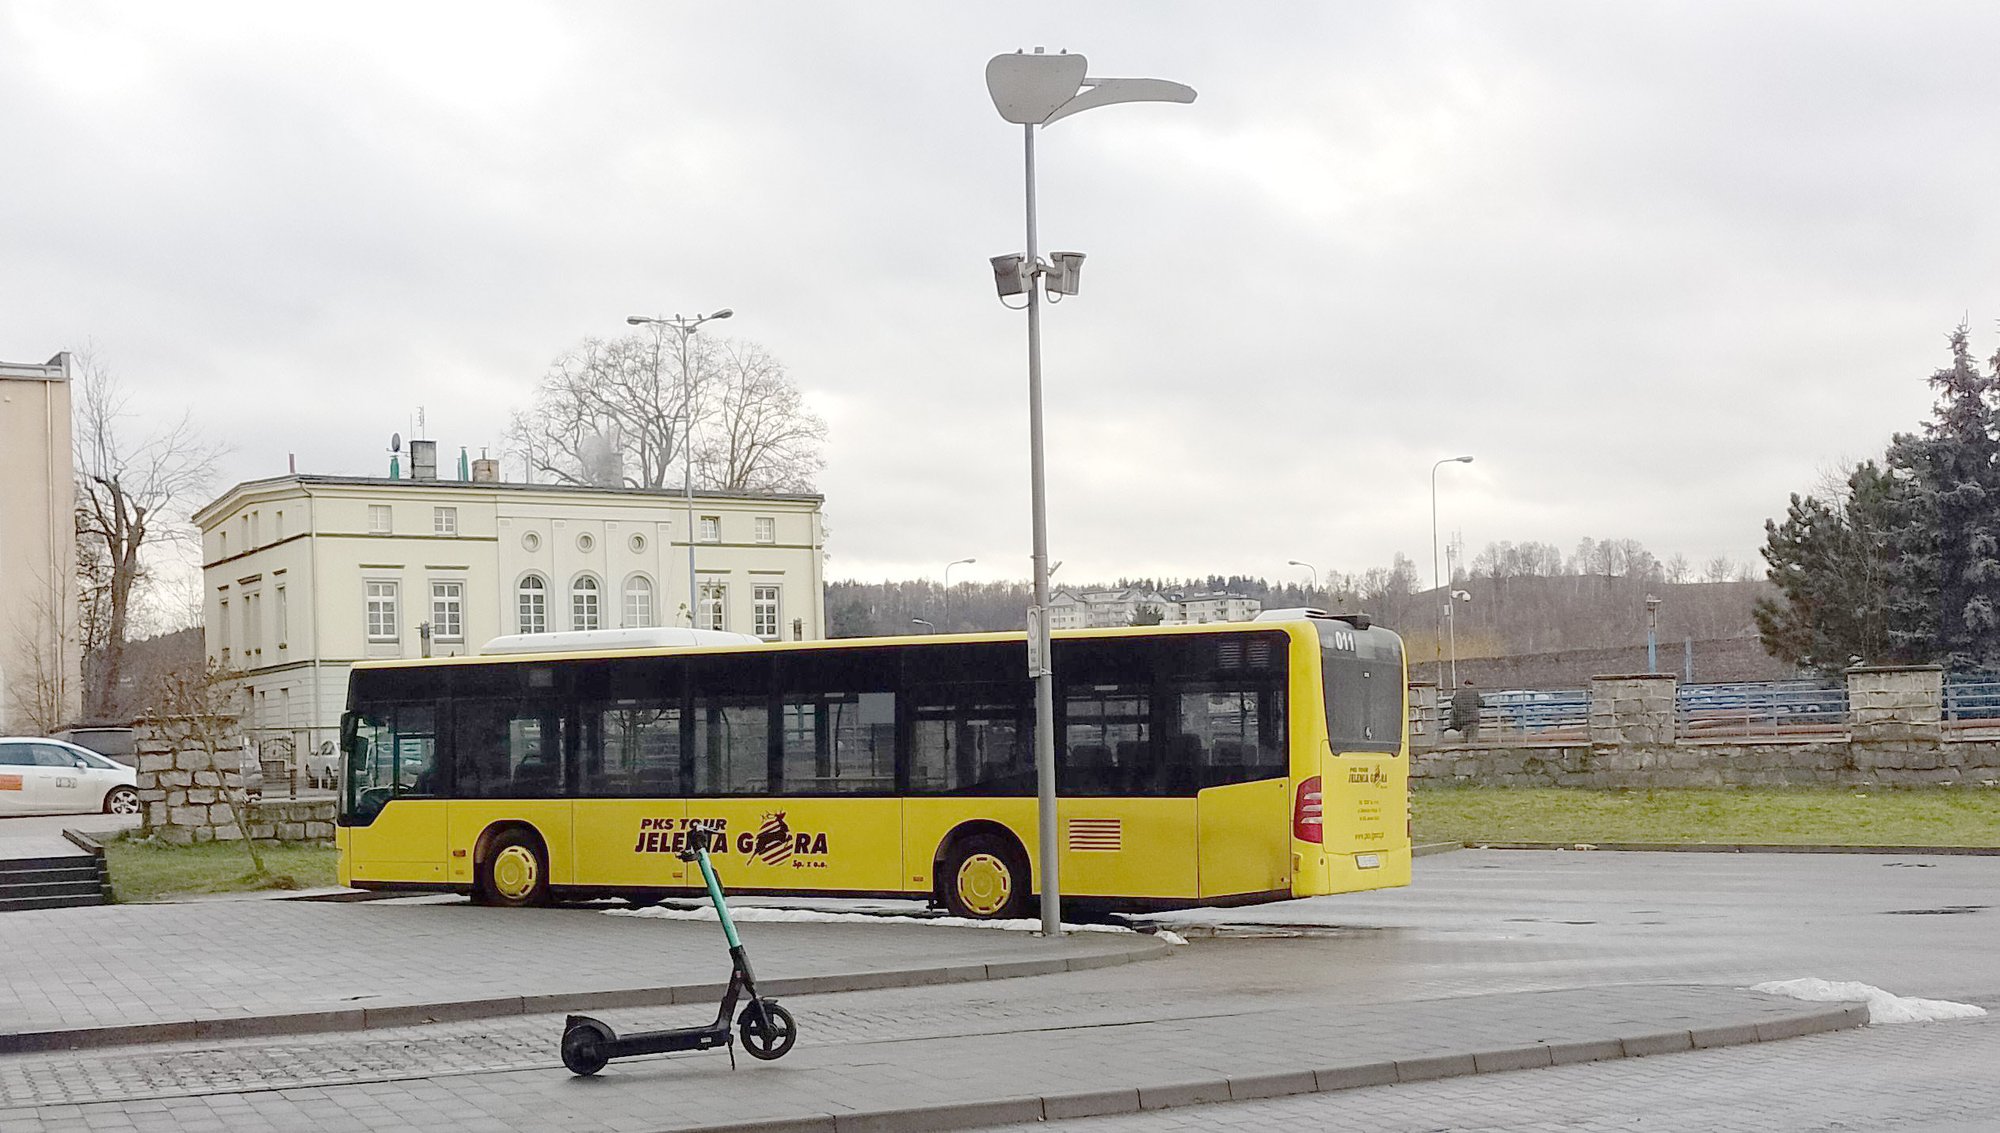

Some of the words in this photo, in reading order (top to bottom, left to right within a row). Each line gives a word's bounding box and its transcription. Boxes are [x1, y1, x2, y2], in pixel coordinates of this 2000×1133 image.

[1335, 631, 1355, 651] 011
[640, 818, 674, 830] PKS
[679, 818, 727, 830] TOUR
